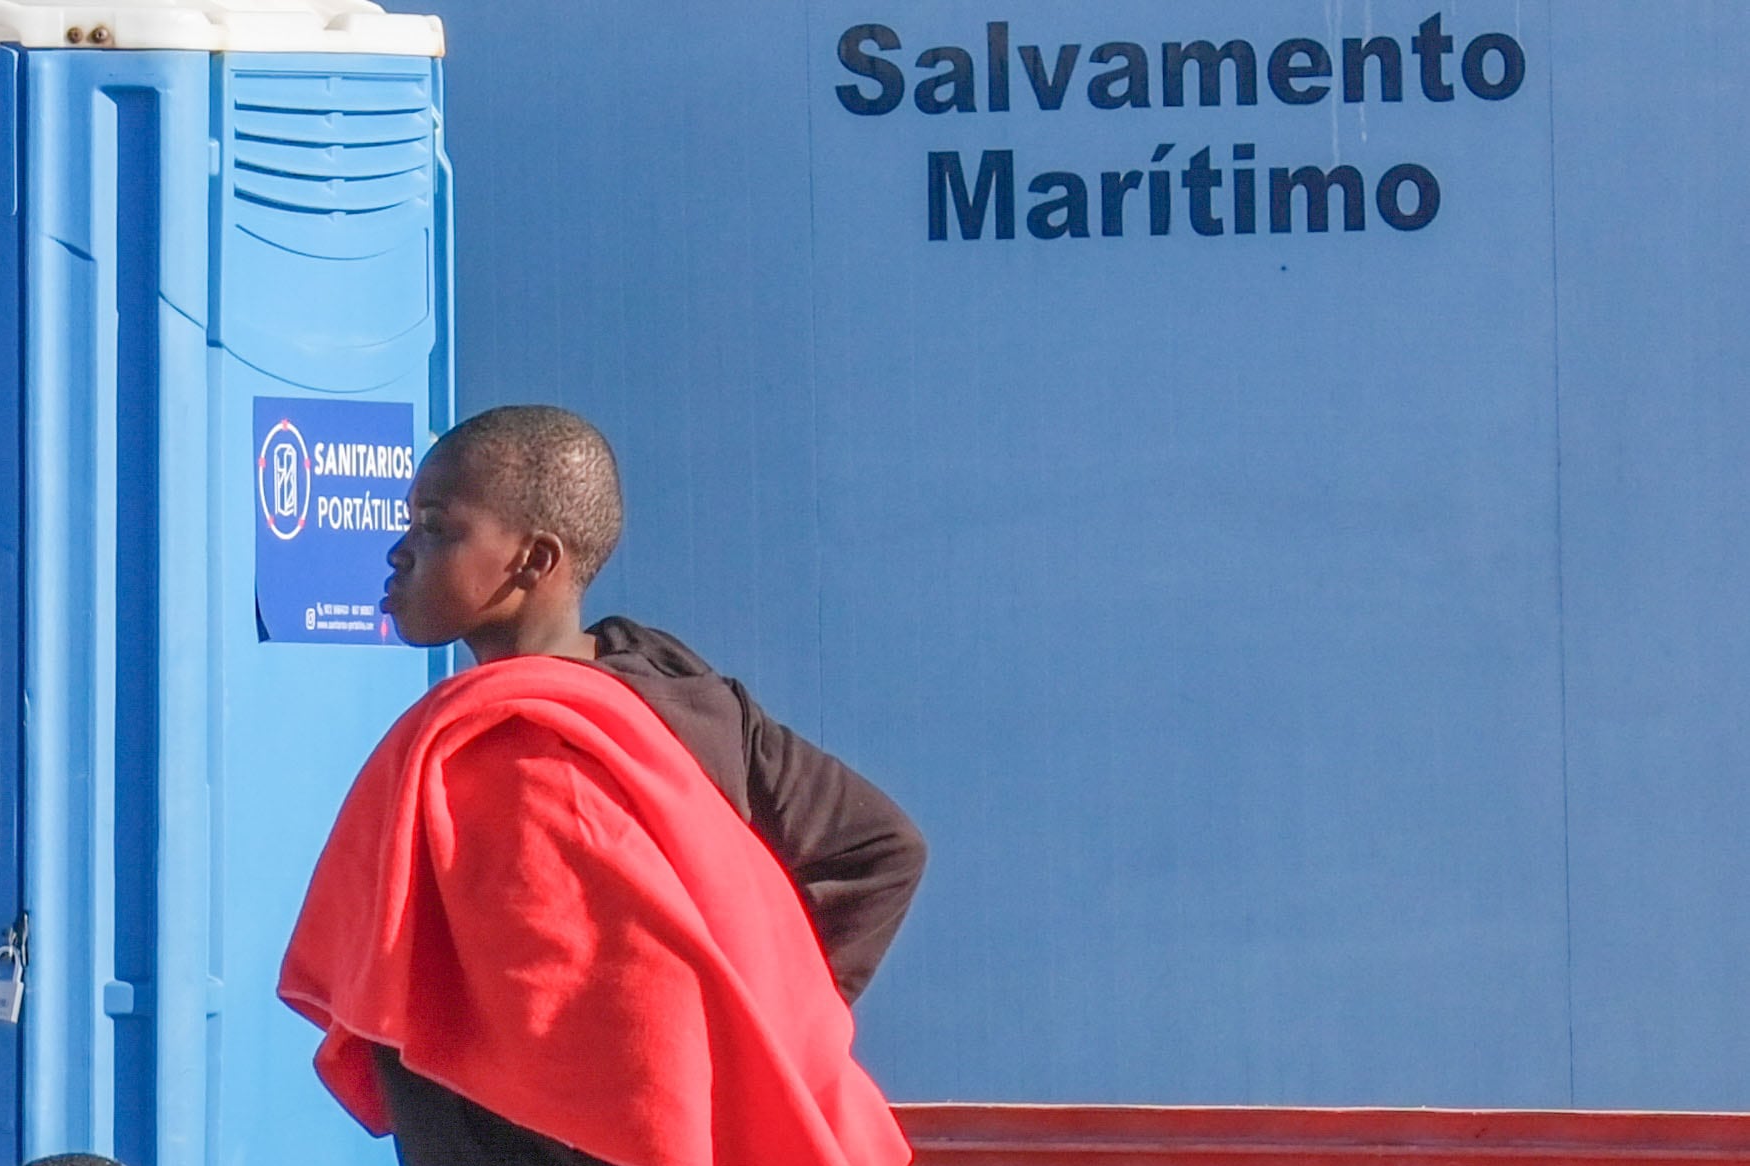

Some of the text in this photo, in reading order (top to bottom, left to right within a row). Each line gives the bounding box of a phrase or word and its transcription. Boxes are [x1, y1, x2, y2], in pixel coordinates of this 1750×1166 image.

[835, 12, 1526, 116] Salvamento
[927, 143, 1441, 241] Marítimo
[314, 442, 413, 479] SANITARIOS
